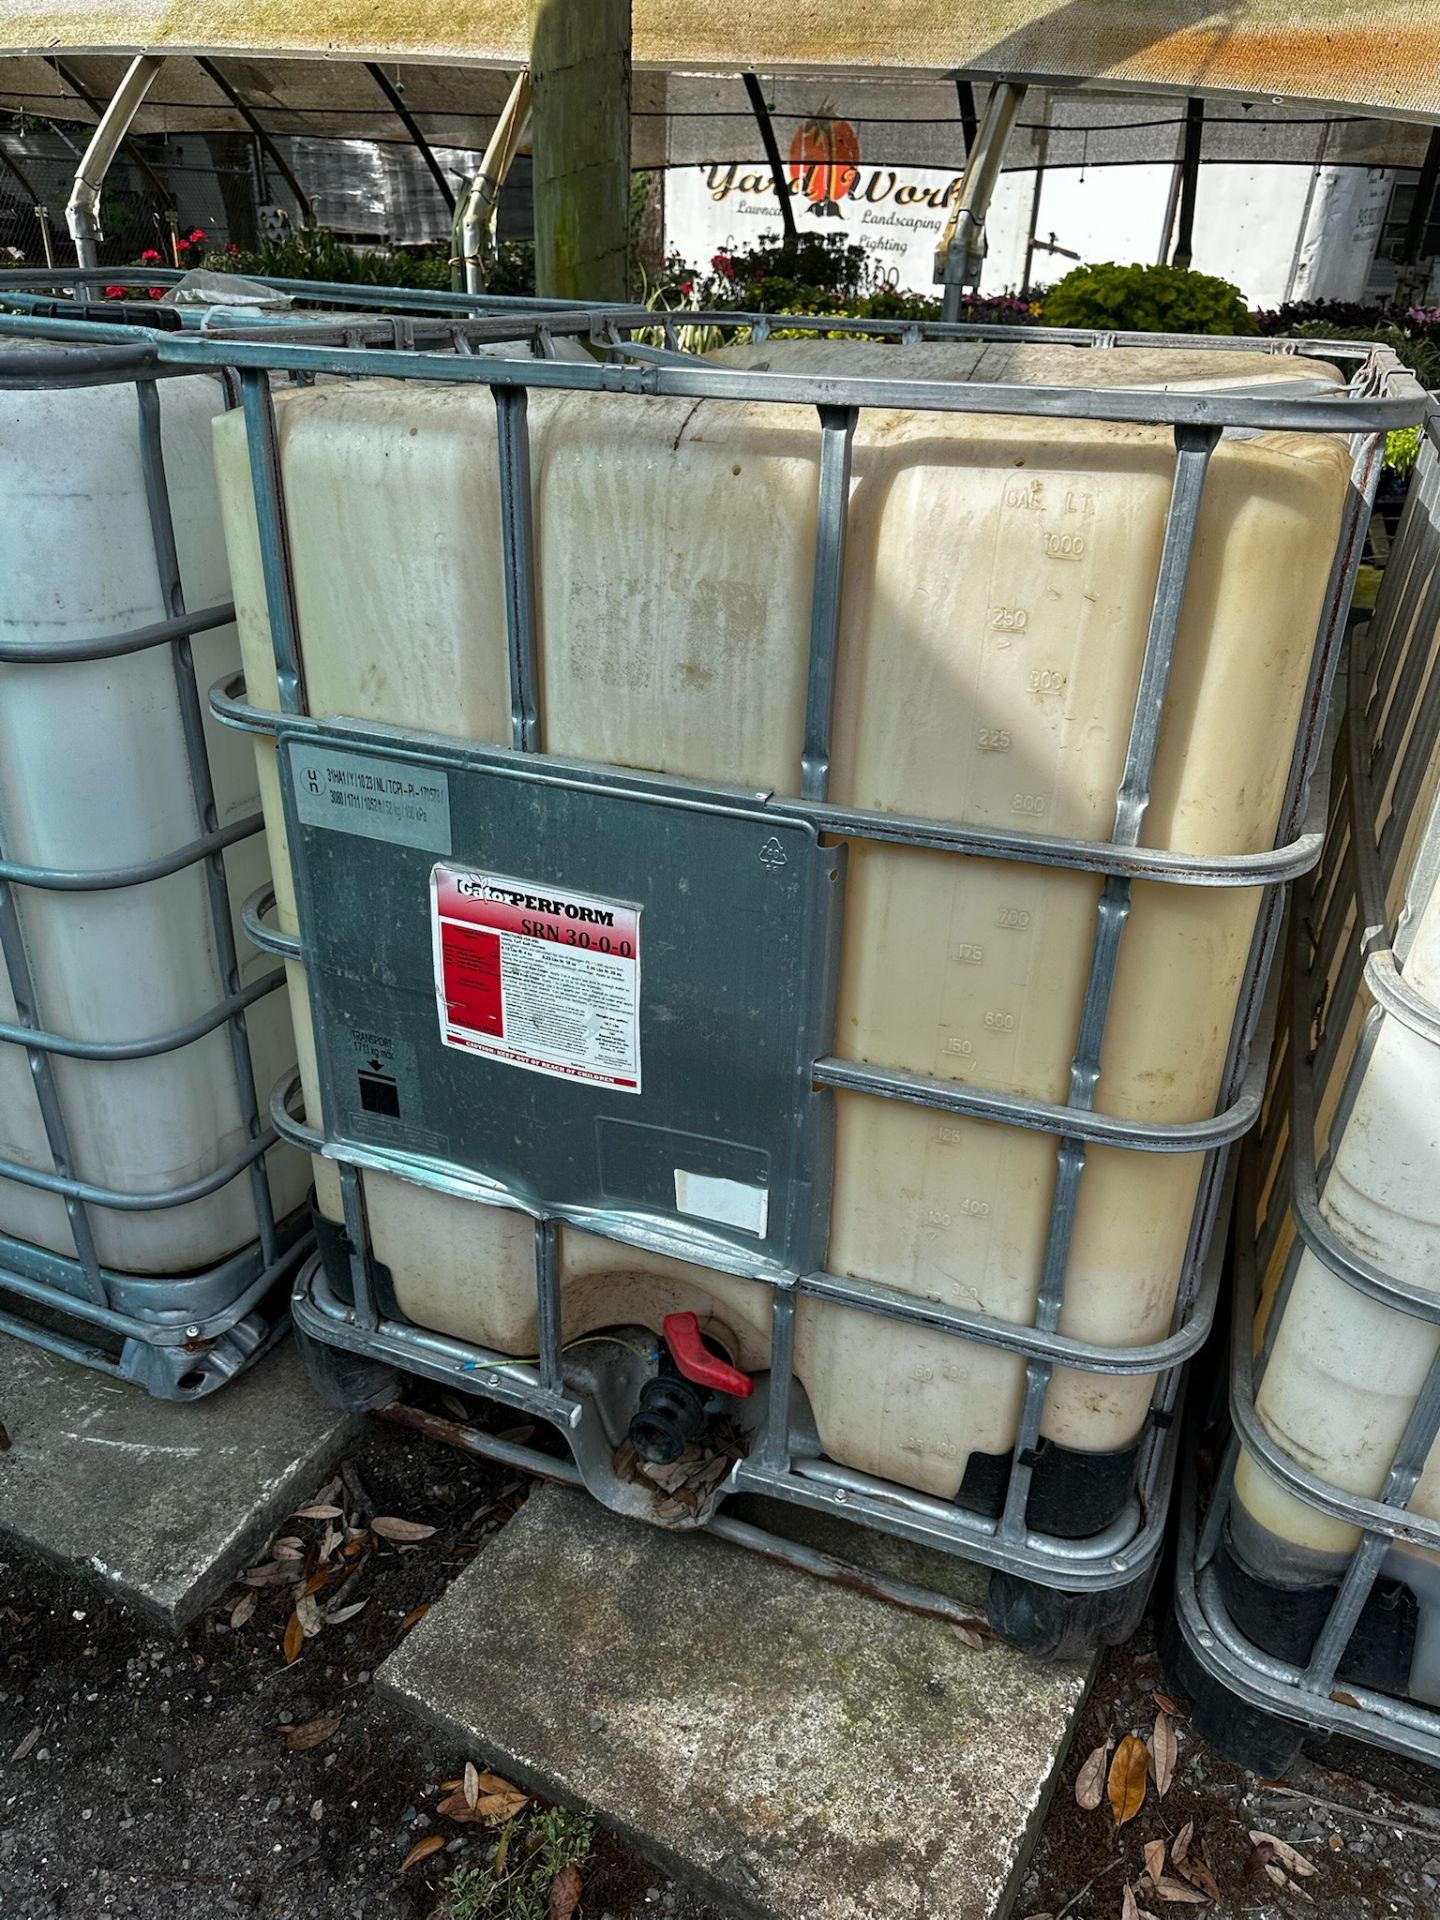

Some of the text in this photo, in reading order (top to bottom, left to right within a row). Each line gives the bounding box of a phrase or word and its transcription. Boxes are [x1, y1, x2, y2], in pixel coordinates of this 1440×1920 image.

[736, 199, 783, 217] Lawnca
[861, 210, 942, 234] Landscaping
[992, 608, 1027, 628] 250
[1030, 669, 1065, 689] 900
[978, 727, 1011, 748] 225
[1012, 793, 1046, 812] 800
[998, 907, 1030, 926] 700
[521, 918, 632, 957] SRN 30-0-0
[958, 943, 984, 960] 175
[984, 1010, 1015, 1029] 600
[352, 1029, 393, 1048] TRANSPORT
[948, 1037, 973, 1053] 150
[466, 1041, 497, 1055] CAUTION:
[497, 1049, 515, 1060] KEEP
[516, 1054, 530, 1064] OUT
[530, 1058, 541, 1066] OF
[541, 1060, 565, 1073] REACH
[566, 1066, 576, 1075] OF
[577, 1070, 615, 1084] CHILDREN
[938, 1127, 961, 1143] 125
[961, 1198, 990, 1215] 400
[928, 1210, 952, 1226] 100
